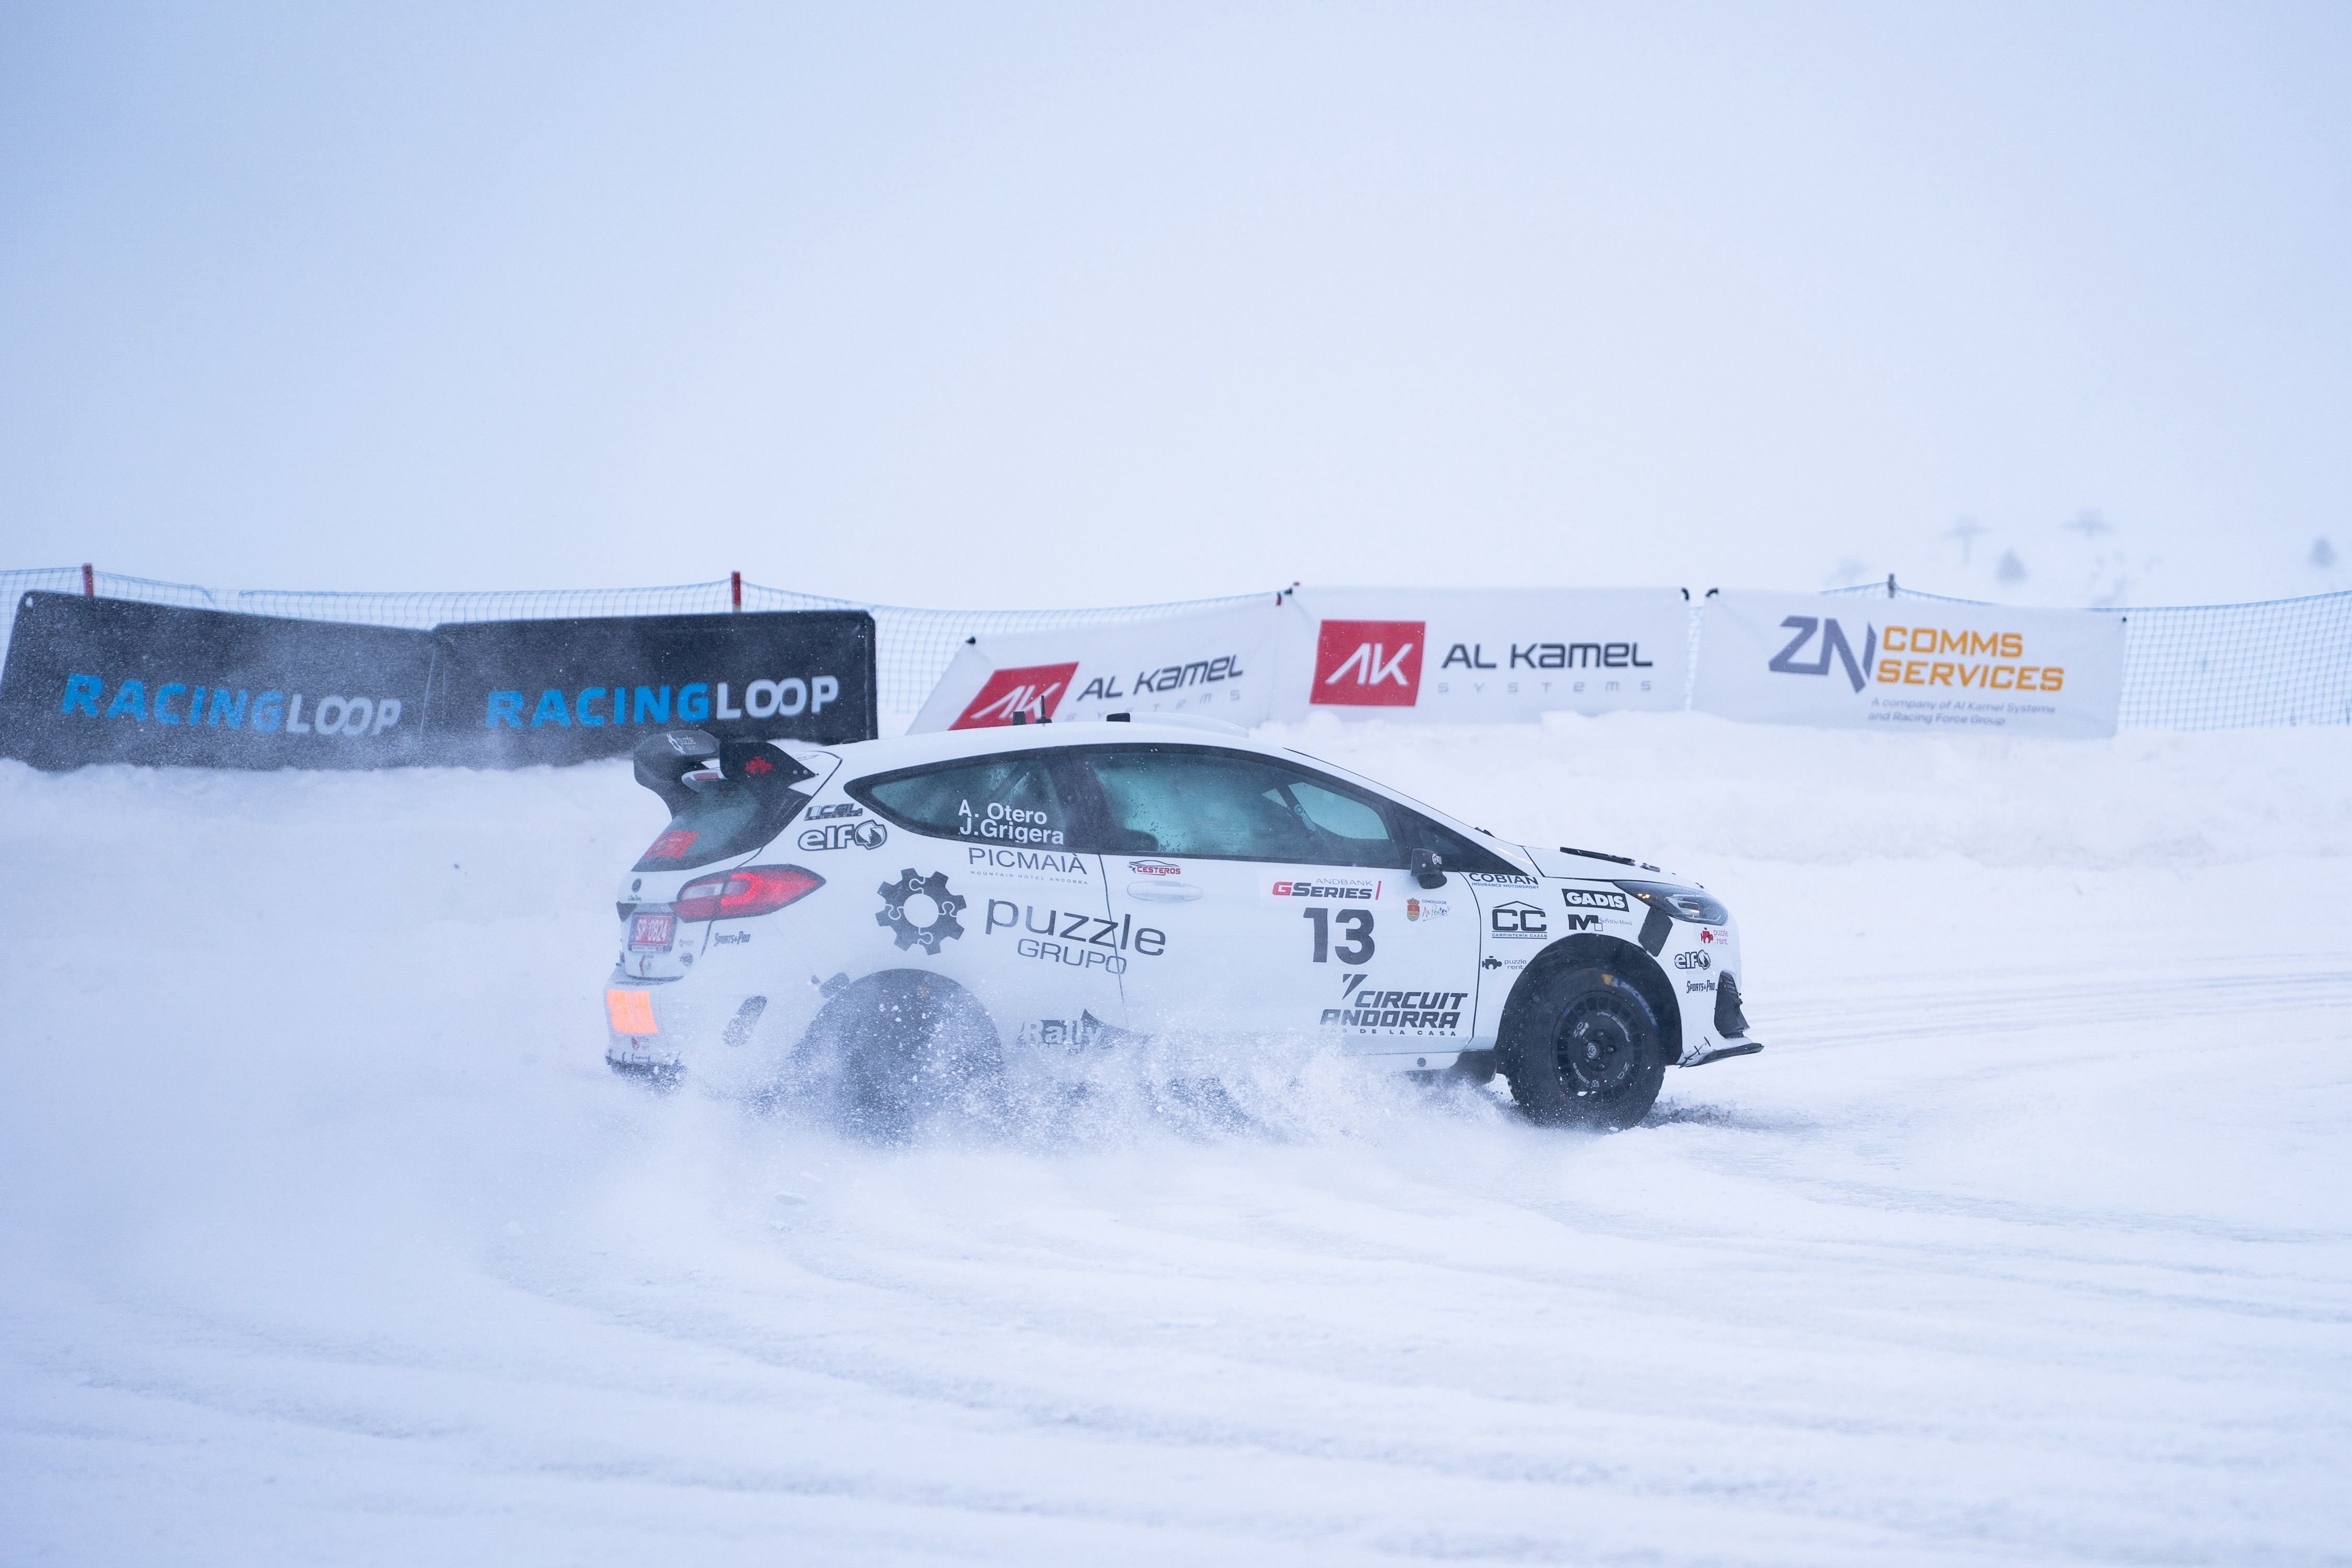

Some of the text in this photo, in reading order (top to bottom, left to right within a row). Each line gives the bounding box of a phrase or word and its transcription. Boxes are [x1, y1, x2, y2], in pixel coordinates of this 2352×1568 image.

[1883, 625, 2023, 659] COMMS
[1440, 643, 1497, 669] AL
[1876, 659, 2065, 691] SERVICES
[1077, 676, 1122, 701] AL
[1871, 697, 1880, 706] A
[1882, 698, 1936, 710] company
[1939, 699, 1952, 709] of
[1967, 701, 2004, 711] Kamel
[2006, 702, 2057, 714] Systems
[1867, 712, 2006, 725] and Racing Force Group
[958, 799, 1047, 824] A. Otero
[798, 824, 854, 851] elf
[960, 817, 1064, 845] J.Grigera
[969, 847, 1088, 874] PICMAIÀ
[1137, 866, 1181, 875] CESTEROS
[1316, 878, 1374, 886] ANDBANK
[1469, 873, 1538, 885] COBIAN
[1566, 892, 1625, 908] GADIS
[985, 898, 1166, 956] puzzle
[1492, 908, 1547, 931] CC
[1302, 907, 1375, 965] 13
[1018, 938, 1127, 974] GRUPO
[1674, 951, 1698, 969] elf
[1354, 990, 1468, 1010] CIRCUIT
[1320, 1009, 1461, 1028] ANDORRA
